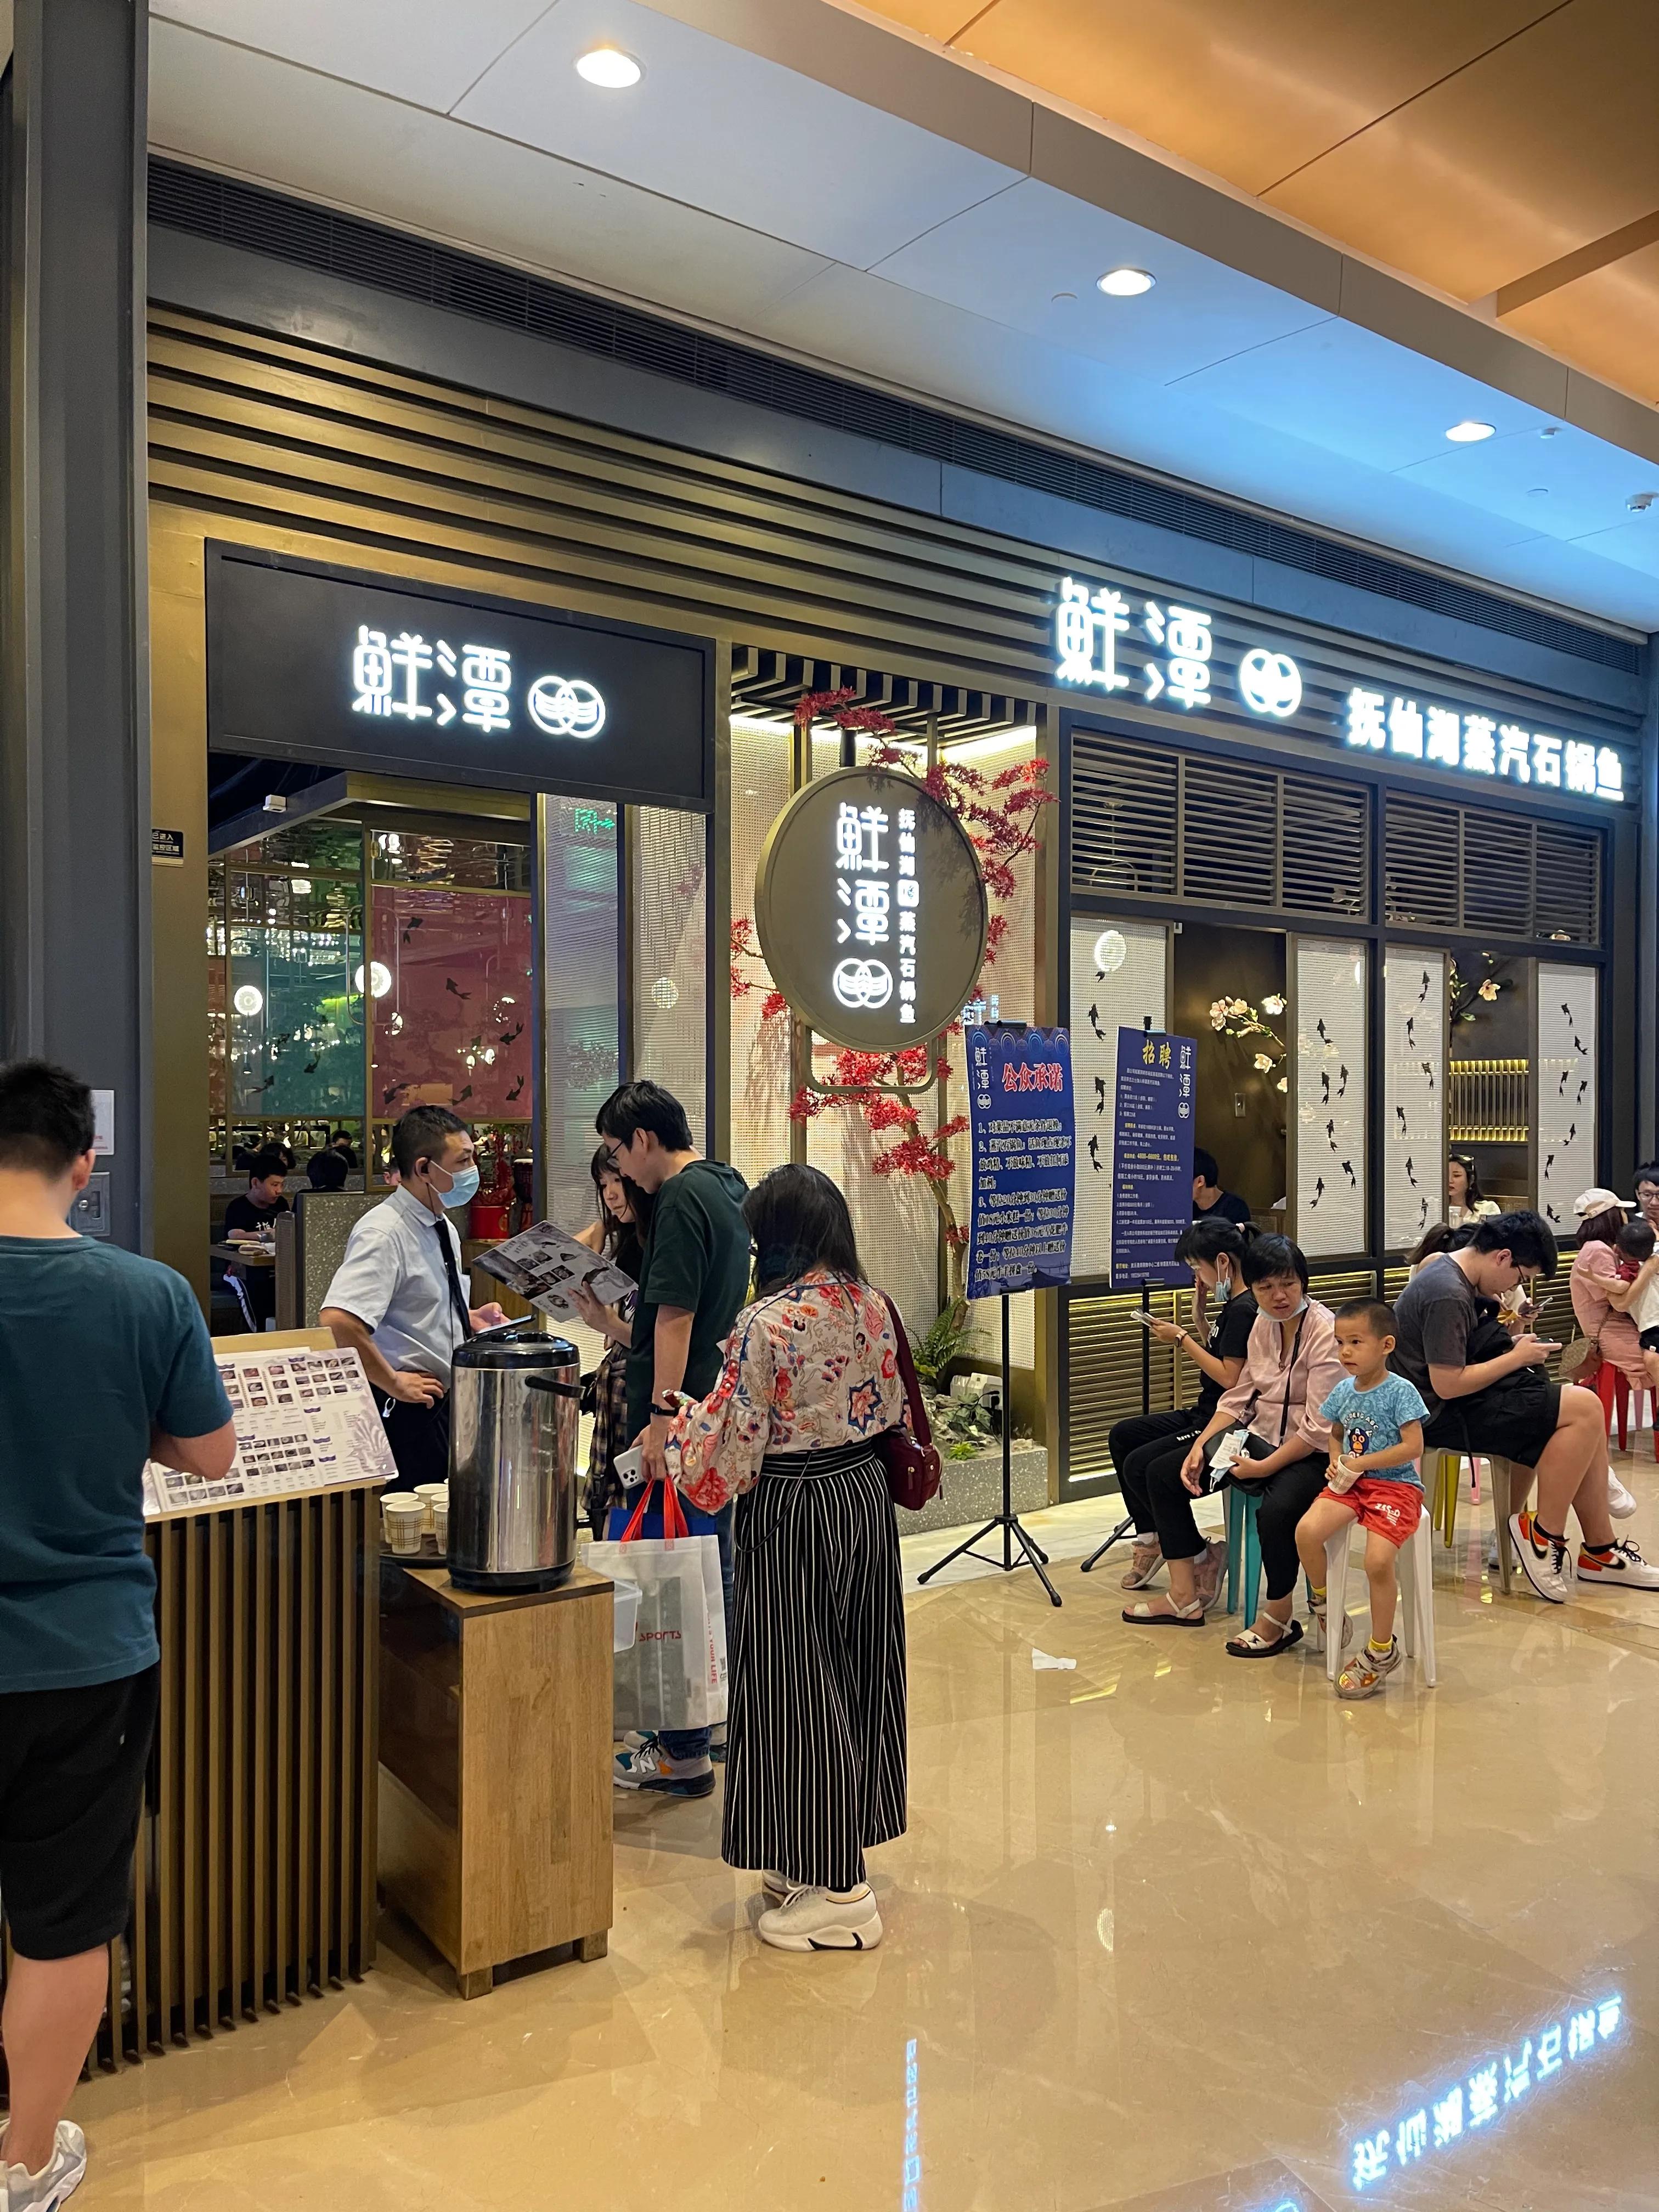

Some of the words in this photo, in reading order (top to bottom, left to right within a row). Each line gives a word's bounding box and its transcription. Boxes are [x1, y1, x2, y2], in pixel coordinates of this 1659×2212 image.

[1347, 687, 1625, 802] 抚仙湖蒸汽石锅鱼
[899, 911, 917, 1024] 蒸汽石锅鱼
[1002, 1062, 1063, 1092] 公众承诺
[1142, 1039, 1172, 1070] 招聘
